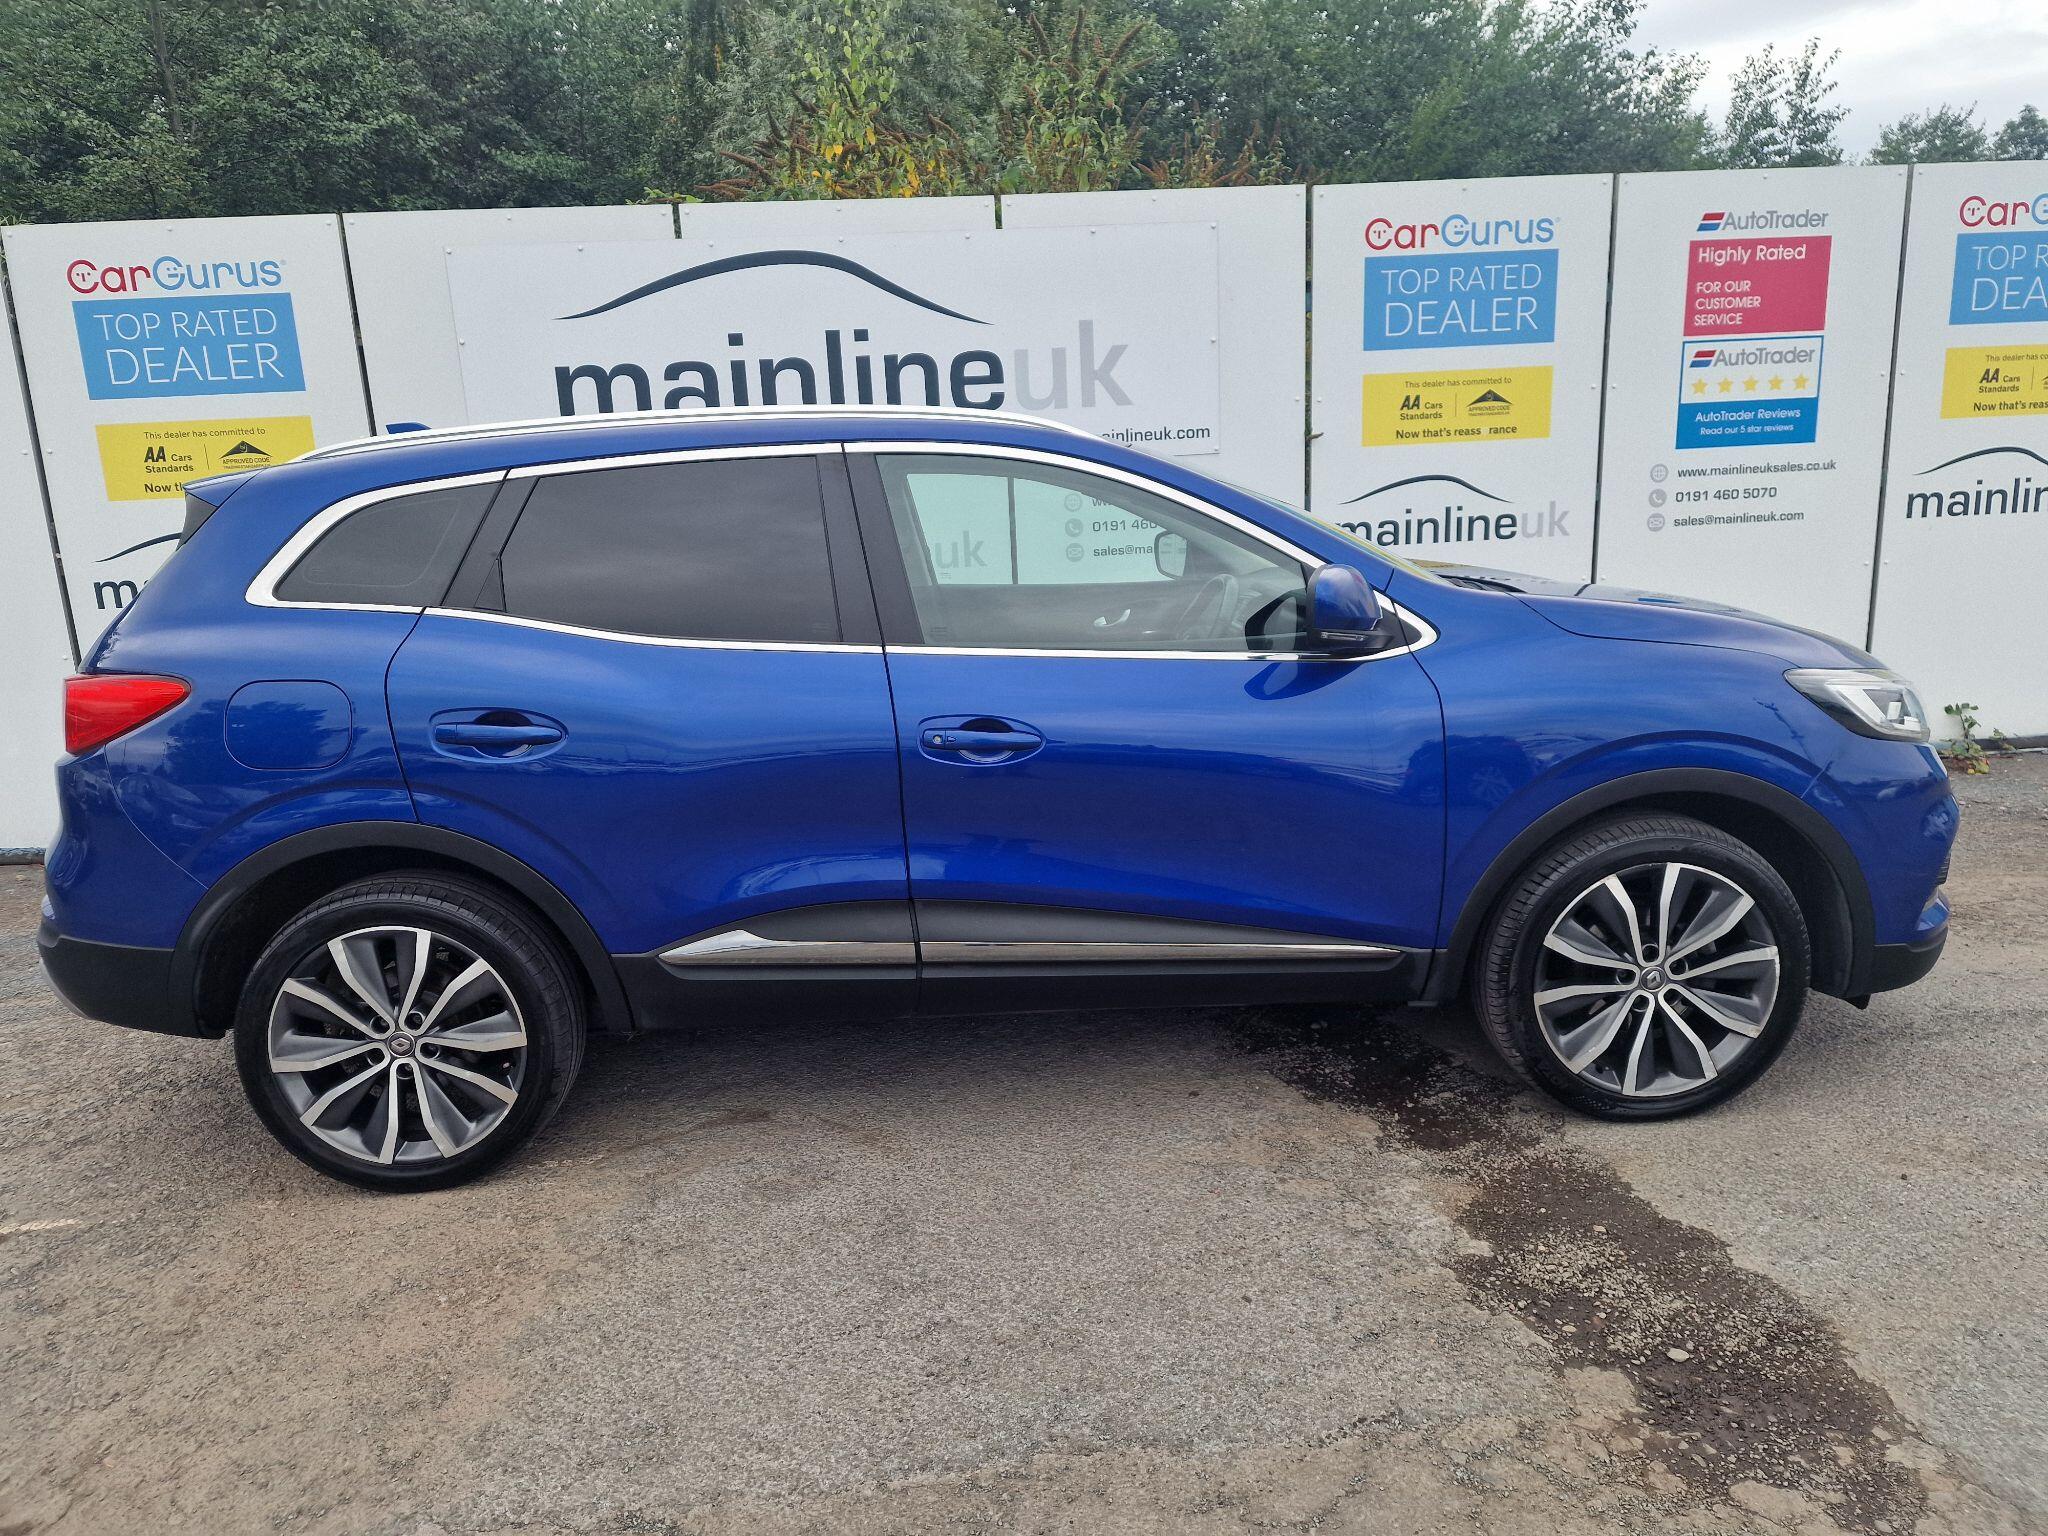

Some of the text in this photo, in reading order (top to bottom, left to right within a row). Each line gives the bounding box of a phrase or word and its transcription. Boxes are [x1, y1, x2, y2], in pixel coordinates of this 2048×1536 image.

[1721, 209, 1828, 232] AutoTrader
[1364, 214, 1554, 250] CarGurus
[1699, 243, 1806, 266] Highly Rated
[1971, 245, 2027, 270] TOP
[67, 256, 282, 294] CarGurus
[1381, 263, 1542, 295] TOP RATED
[1696, 280, 1752, 294] FOR OUR
[1695, 296, 1761, 310] CUSTOMER
[93, 308, 277, 341] TOP RATED
[1385, 296, 1539, 337] DEALER
[1694, 313, 1743, 326] SERVICE
[106, 342, 285, 385] DEALER
[1713, 346, 1816, 368] AutoTrader
[1986, 354, 2001, 362] This
[2002, 353, 2026, 362] dealer
[2026, 353, 2039, 361] has
[1405, 381, 1421, 389] This
[1422, 379, 1445, 388] dealer
[1447, 378, 1461, 387] has
[1462, 377, 1502, 386] committed
[1979, 367, 2021, 383] AA Cars
[1978, 384, 2020, 393] Standards
[1400, 394, 1444, 410] AA Cars
[1973, 402, 1997, 411] Now
[1999, 400, 2027, 410] that's
[1400, 411, 1443, 420] Standards
[1694, 408, 1801, 423] AutoTrader Reviews
[144, 427, 266, 440] This dealer has committed to
[1395, 425, 1518, 439] Now that's reassrance
[1700, 427, 1723, 435] Read
[1740, 425, 1746, 433] 5
[1747, 424, 1762, 433] star
[1763, 423, 1794, 432] reviews
[144, 446, 193, 463] AA Cars
[145, 464, 195, 474] Standards
[1677, 458, 1838, 478] www.mainlineuksales.co.uk
[144, 483, 172, 494] Now
[1675, 487, 1777, 503] 0191 460 5070
[1092, 520, 1126, 532] 0191
[1674, 511, 1804, 527] sales@mainlineuk.com
